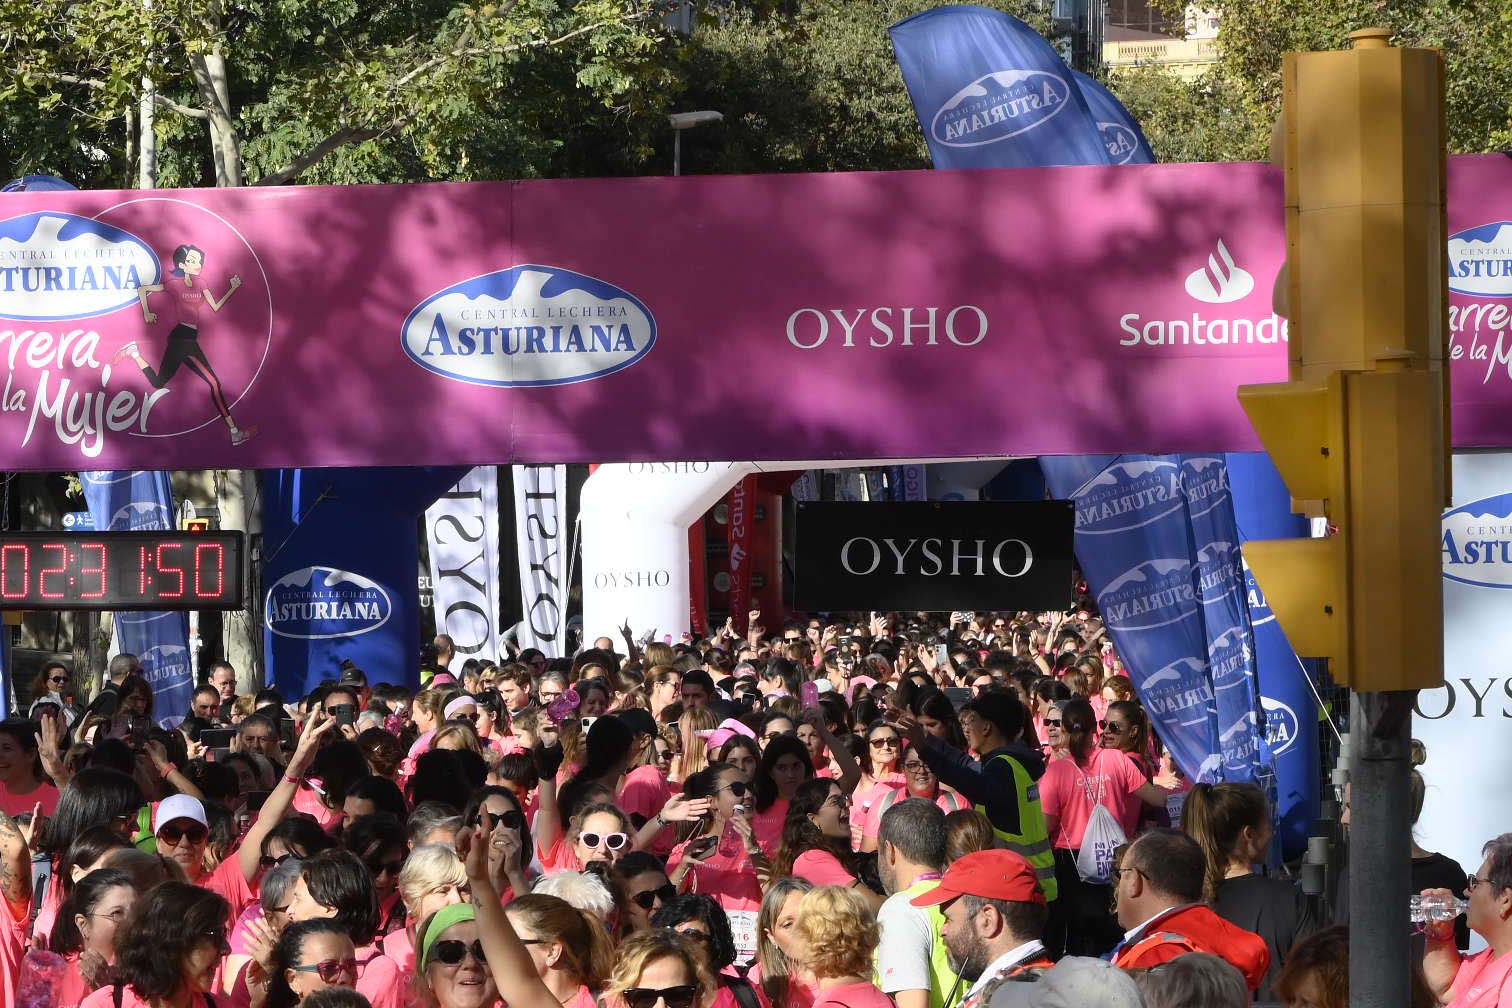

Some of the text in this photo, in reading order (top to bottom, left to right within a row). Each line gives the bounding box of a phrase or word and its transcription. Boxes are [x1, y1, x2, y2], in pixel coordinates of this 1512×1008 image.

[461, 306, 628, 320] CENTRAL LECHERA
[786, 304, 990, 350] OYSHO
[420, 311, 637, 356] ASTURIANA
[1120, 312, 1288, 347] Santand
[1469, 331, 1487, 360] la
[1, 372, 27, 413] la
[21, 363, 171, 458] Mujer
[840, 537, 1034, 577] OYSHO
[283, 590, 378, 600] CENTRAL LECHERA
[594, 570, 671, 591] OYSHO
[270, 598, 382, 624] ASTURIANA
